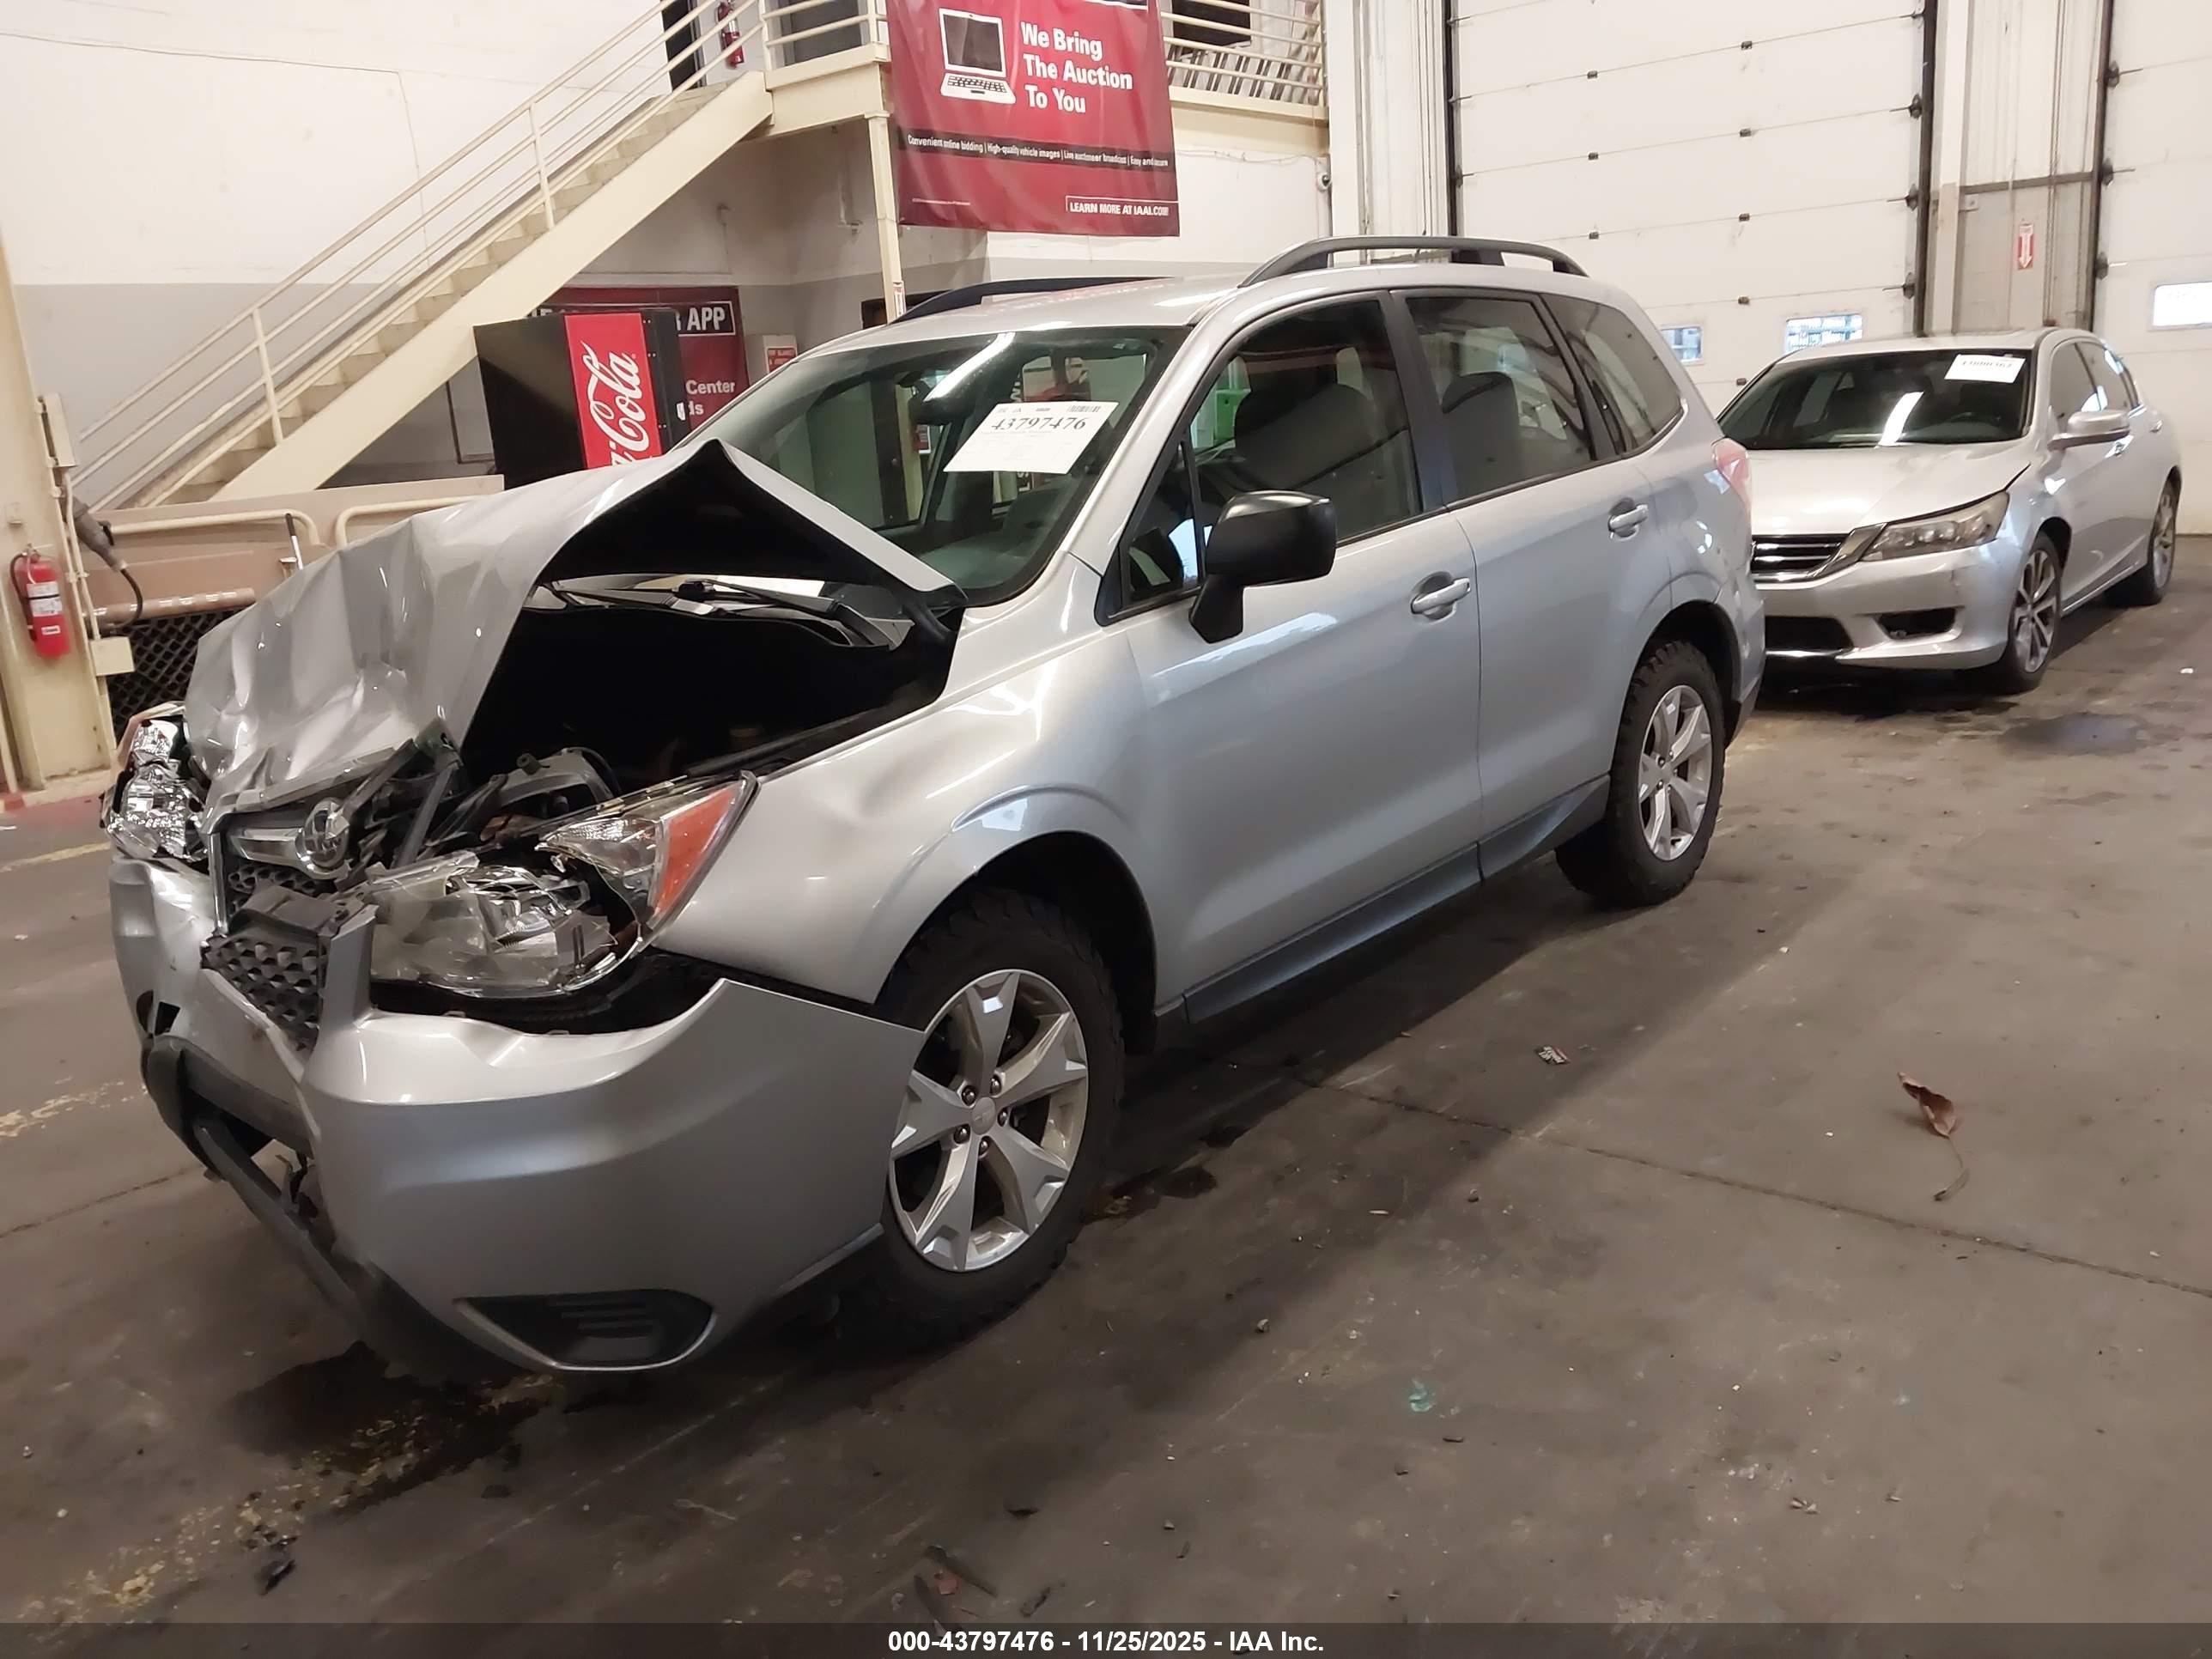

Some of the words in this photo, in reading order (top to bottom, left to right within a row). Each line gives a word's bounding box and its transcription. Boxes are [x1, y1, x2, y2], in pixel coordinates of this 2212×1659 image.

[1020, 21, 1049, 47] We
[1053, 27, 1103, 62] Bring
[1023, 53, 1058, 79] The
[1063, 59, 1133, 89] Auction
[1024, 84, 1048, 108] To
[1052, 87, 1086, 112] You
[908, 134, 943, 148] Convenient
[961, 140, 983, 153] bidding
[1038, 148, 1060, 159] images
[1070, 202, 1098, 213] LEARN
[1099, 203, 1121, 214] MORE
[1121, 205, 1133, 215] AT
[687, 307, 726, 331] APP
[685, 379, 736, 395] Center
[991, 416, 1092, 430] 43797476
